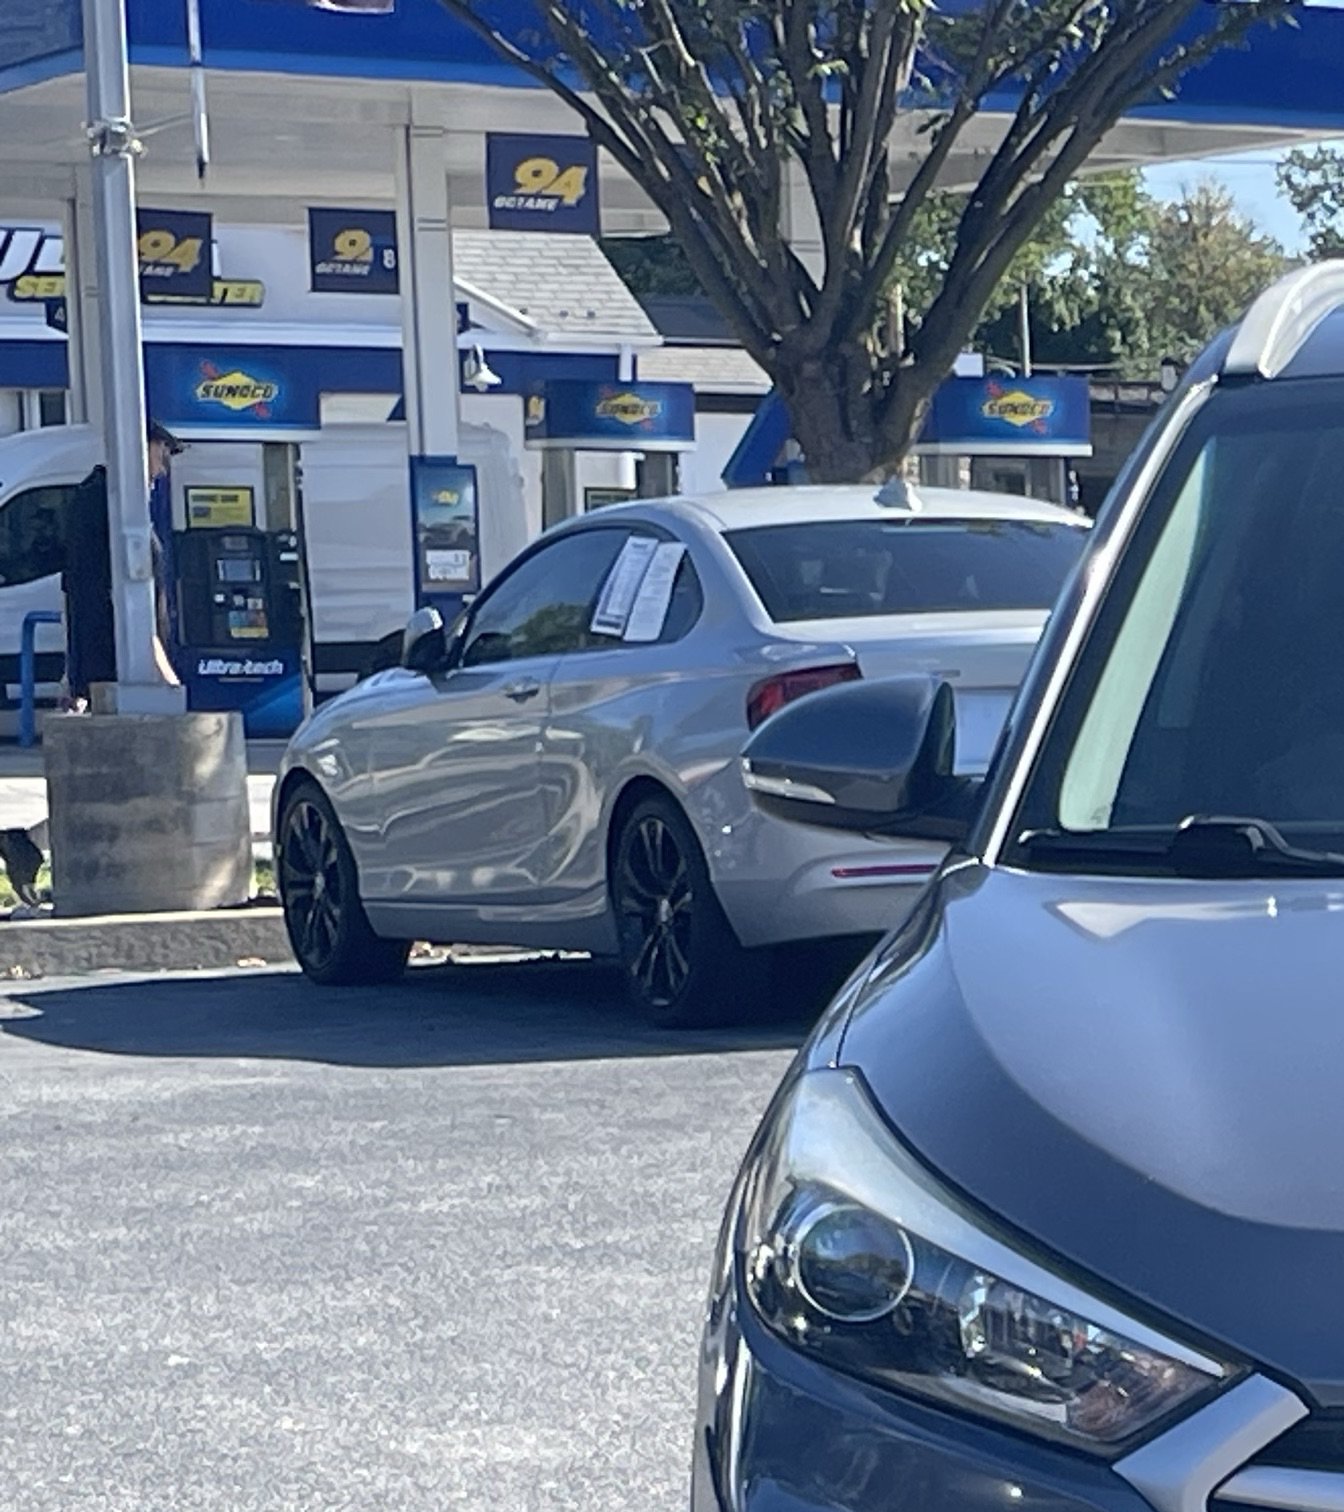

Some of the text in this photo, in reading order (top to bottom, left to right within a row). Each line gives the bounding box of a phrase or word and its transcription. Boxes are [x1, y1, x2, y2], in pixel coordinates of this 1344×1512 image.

[512, 157, 588, 206] 94
[493, 196, 559, 211] OCTANE
[201, 382, 273, 399] SUNOCO
